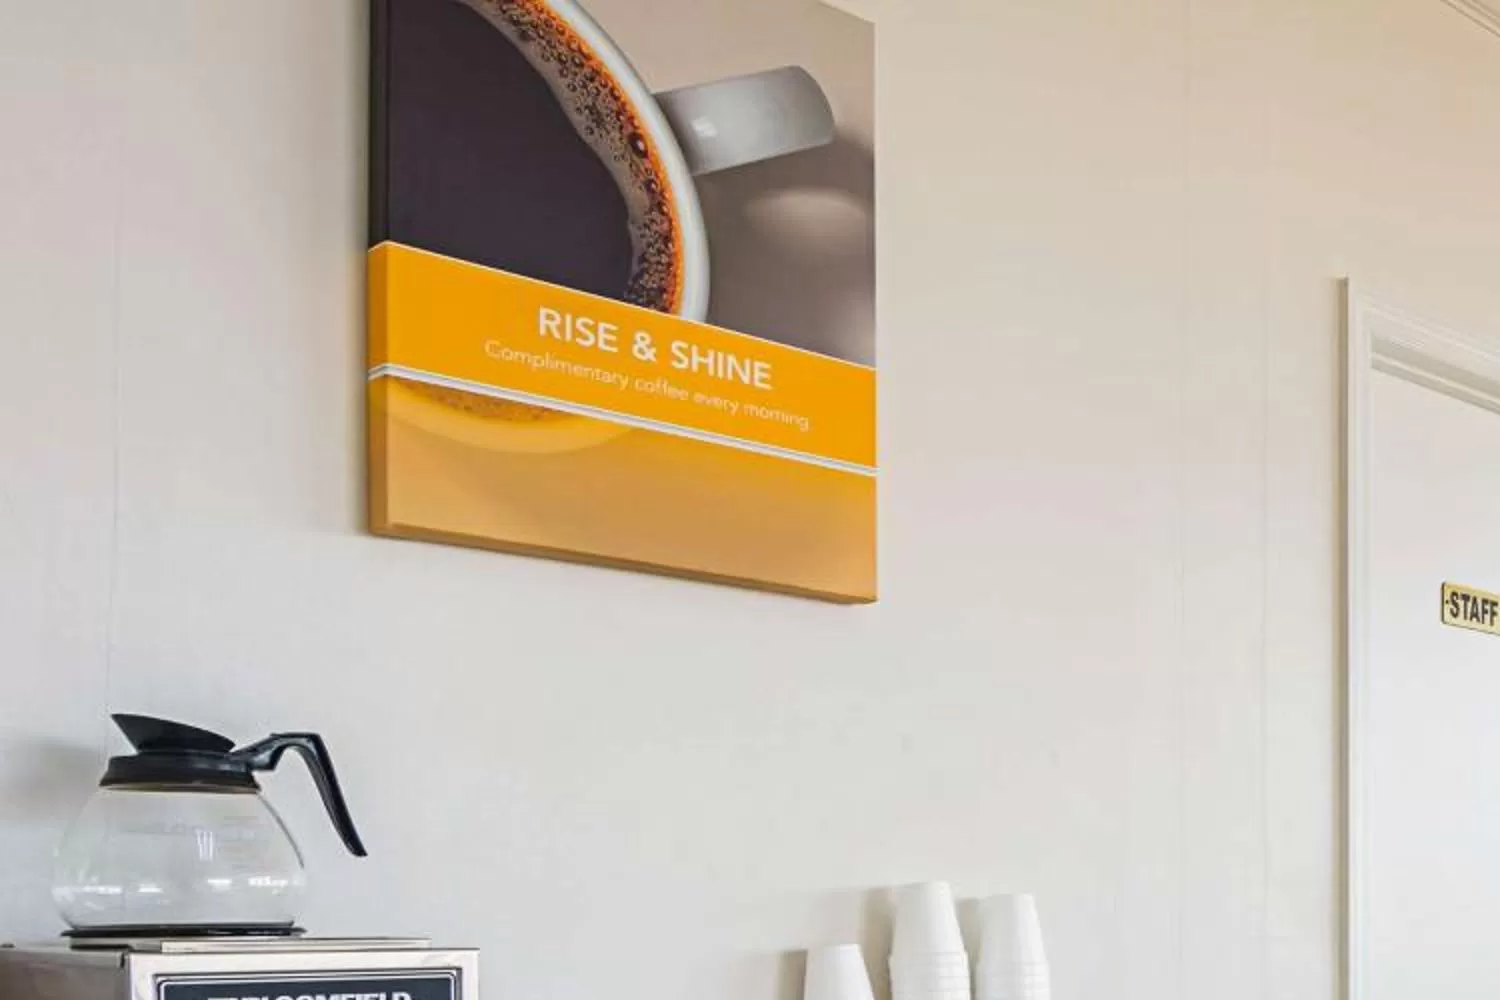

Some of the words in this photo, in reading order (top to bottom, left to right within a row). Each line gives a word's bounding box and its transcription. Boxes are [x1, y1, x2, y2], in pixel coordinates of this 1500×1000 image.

[484, 339, 630, 391] Complimentary
[633, 376, 690, 402] coffee
[694, 390, 741, 416] every
[742, 403, 810, 433] morning
[537, 305, 619, 353] RISE
[631, 330, 658, 363] &
[670, 341, 773, 390] SHINE
[1450, 591, 1498, 626] STAFF
